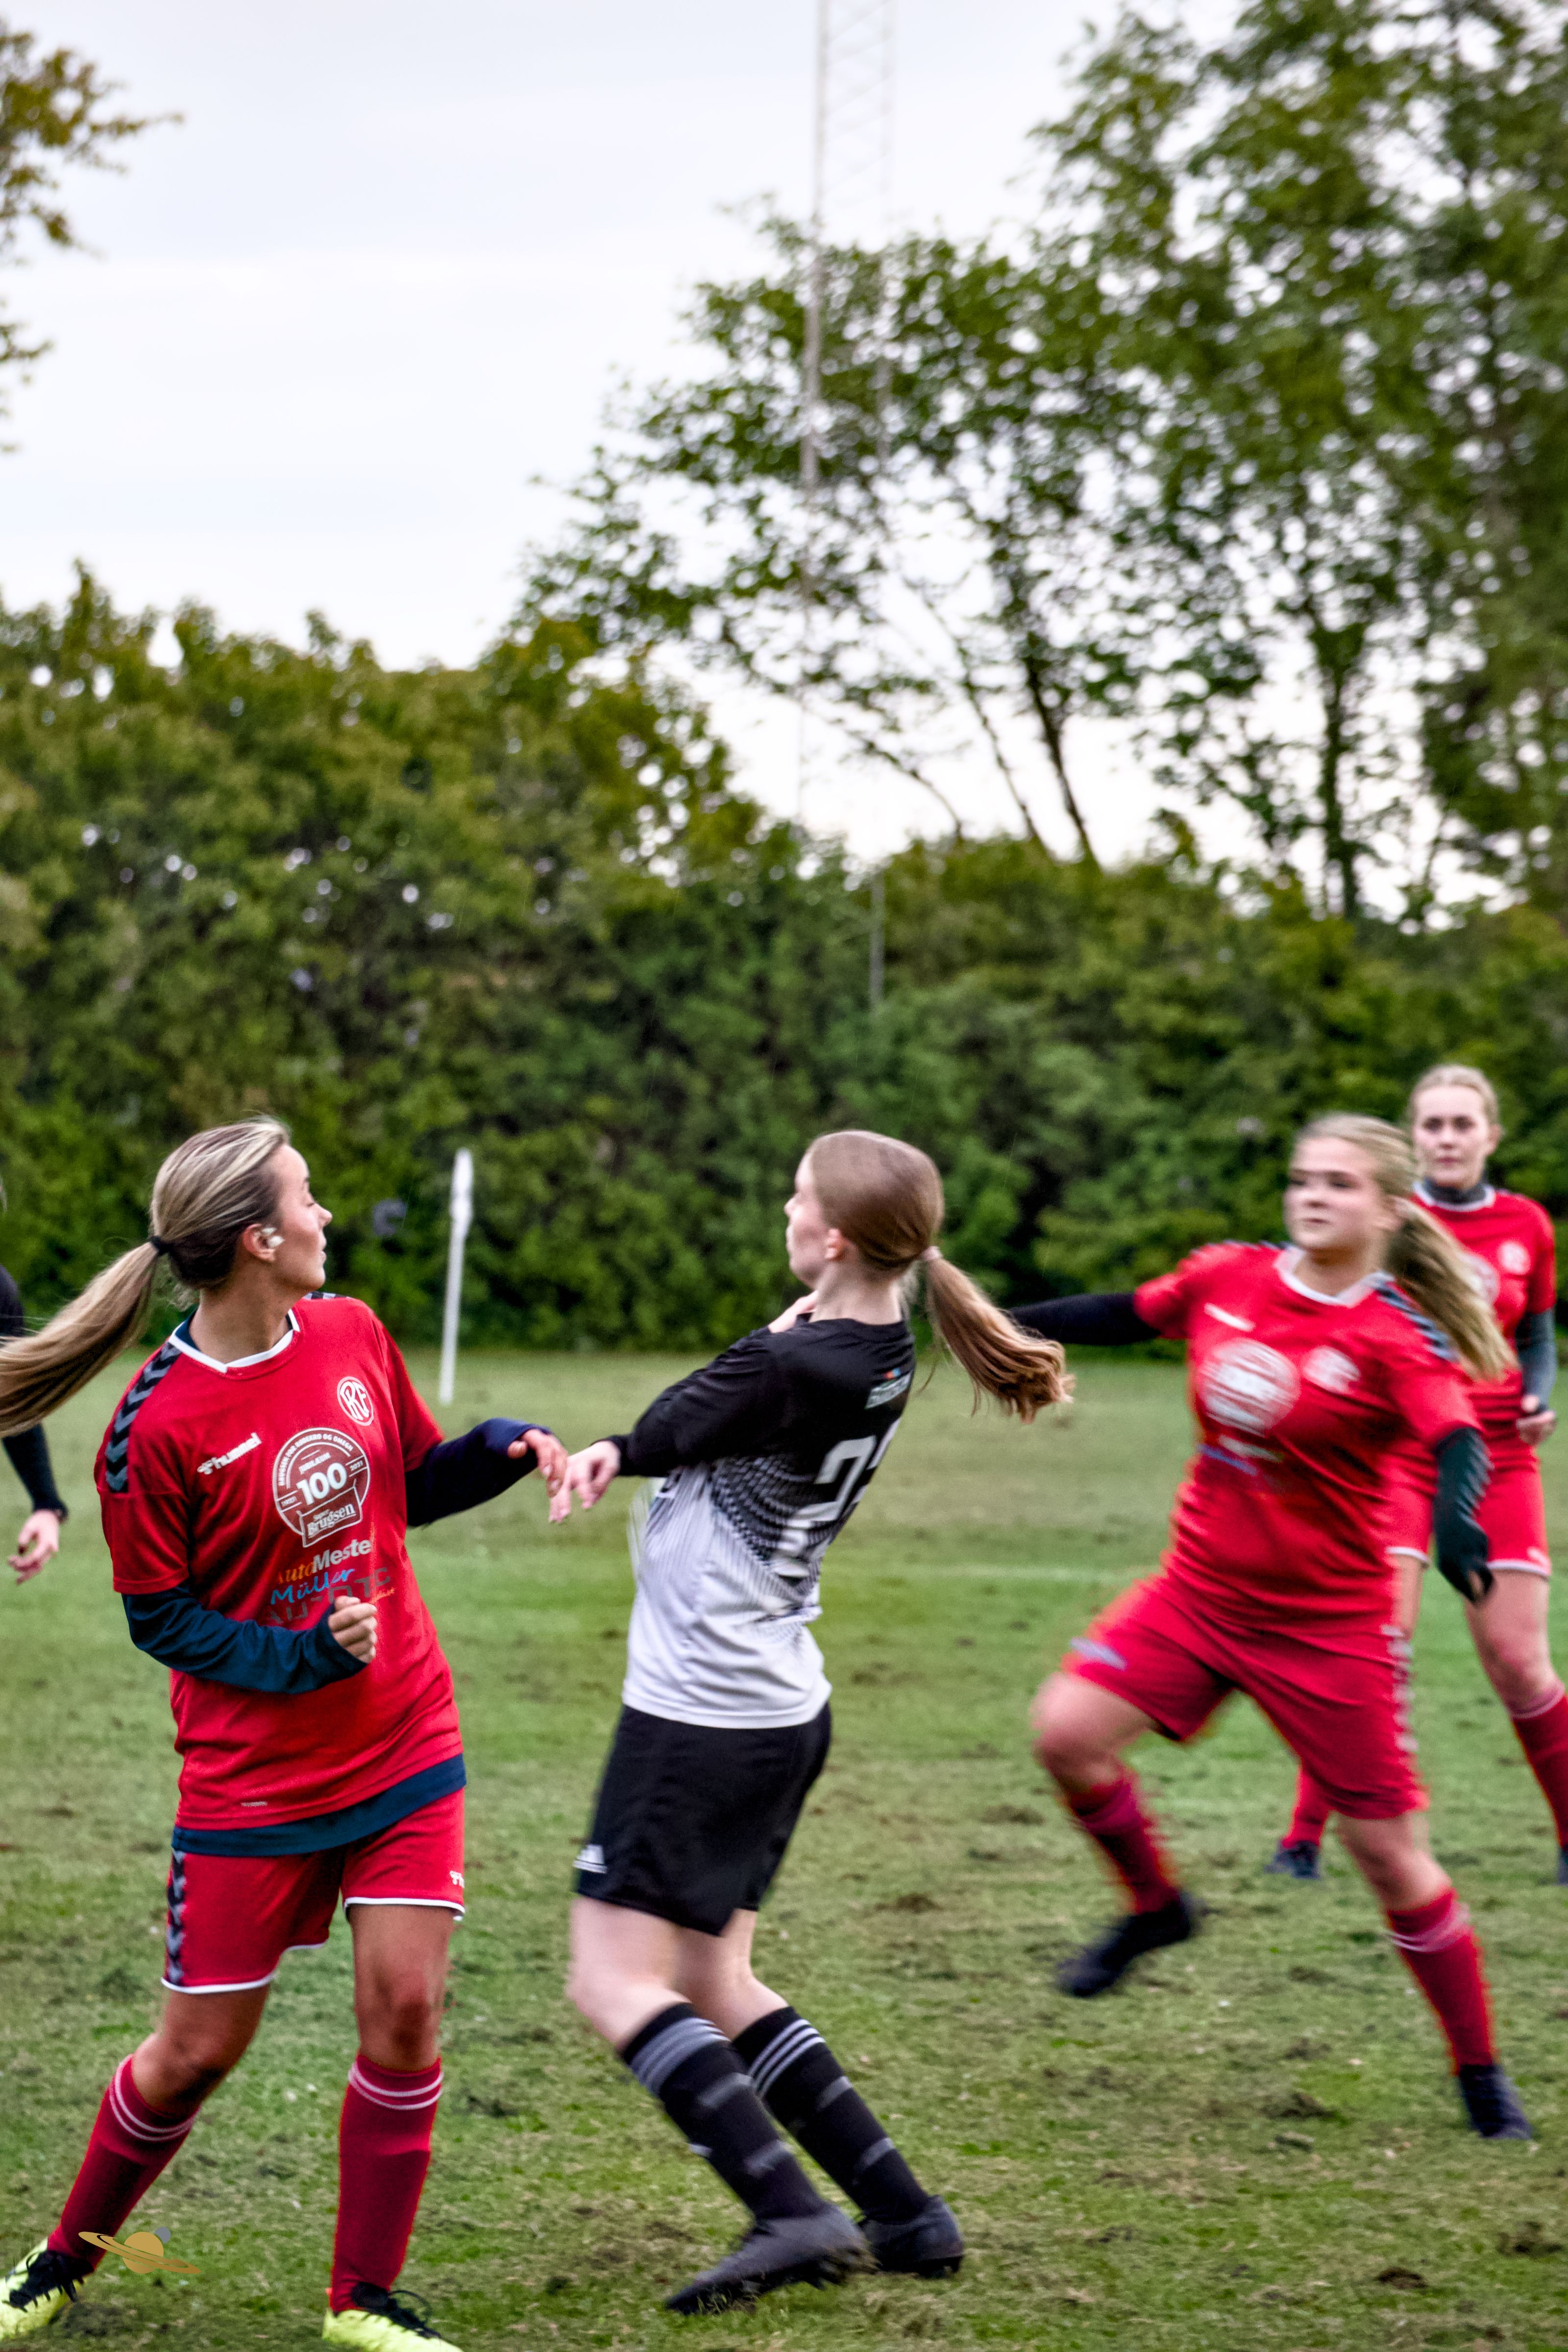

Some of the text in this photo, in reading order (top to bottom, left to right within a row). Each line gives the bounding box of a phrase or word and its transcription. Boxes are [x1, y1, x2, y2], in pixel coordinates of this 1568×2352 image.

[333, 1436, 354, 1452] OMEGN
[296, 1463, 347, 1505] 100
[307, 1503, 356, 1536] Brugsen
